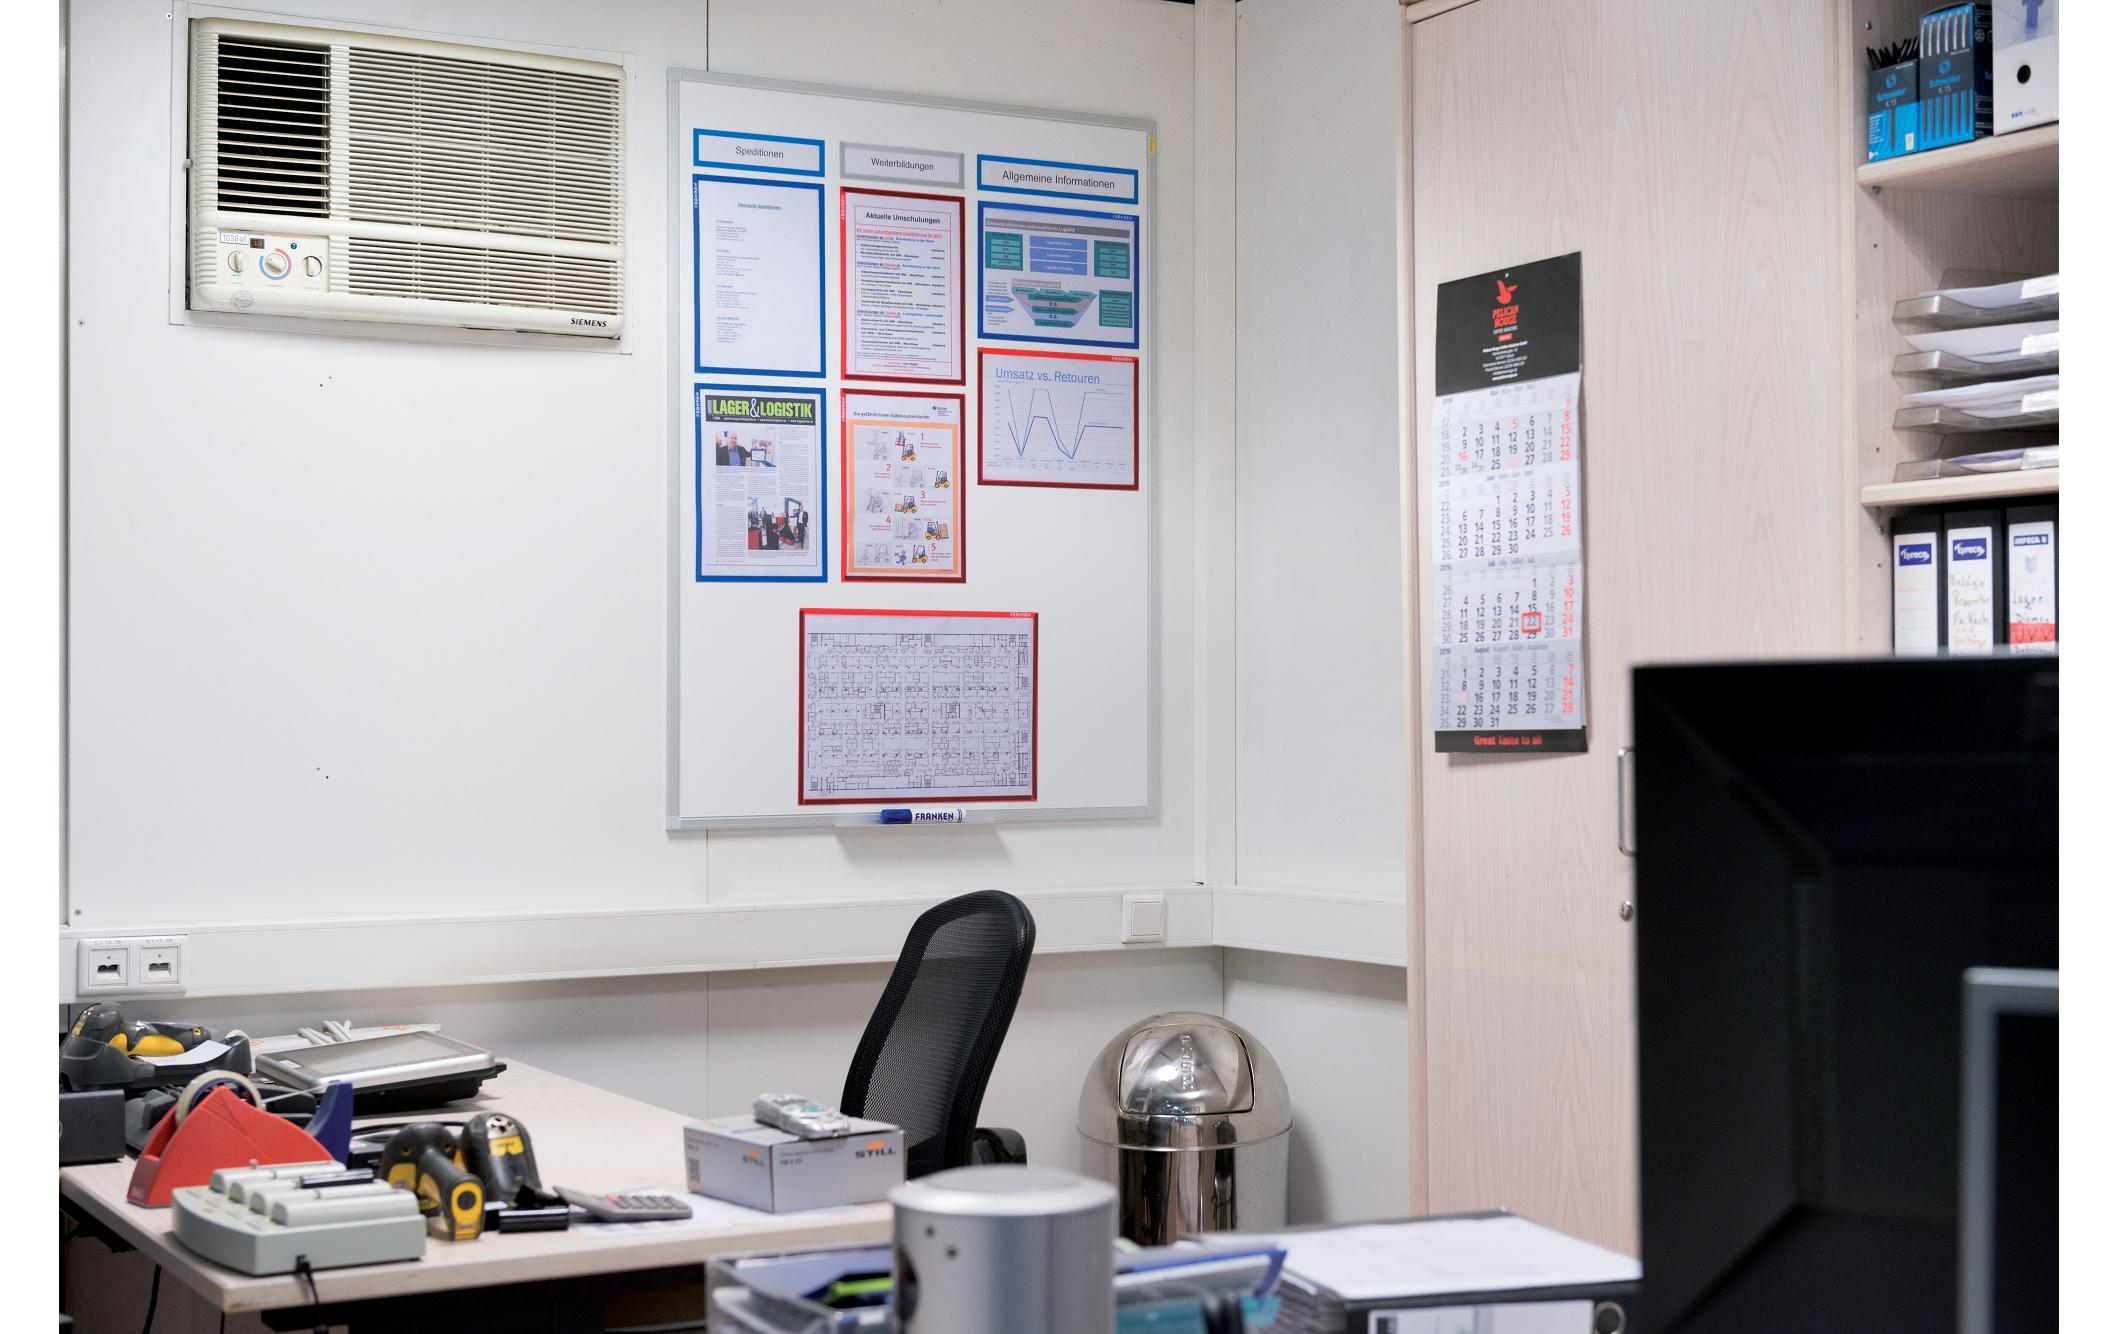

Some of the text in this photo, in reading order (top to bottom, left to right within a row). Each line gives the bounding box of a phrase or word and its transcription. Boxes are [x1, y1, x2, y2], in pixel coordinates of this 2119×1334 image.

[736, 146, 784, 159] Speditionen
[871, 157, 934, 171] Weiterbildungen
[1002, 170, 1115, 189] Allgemeine Informationen
[866, 212, 940, 224] Aktuelle Umschulungen
[570, 317, 607, 328] SIEMENS
[996, 368, 1100, 384] Umsatz vs. Retouren
[1463, 427, 1466, 436] 2
[1480, 424, 1483, 434] 3
[1495, 422, 1499, 431] 4
[1530, 417, 1534, 426] 6
[1463, 440, 1467, 449] 9
[1476, 437, 1484, 446] 10
[1492, 435, 1499, 444] 11
[1509, 432, 1517, 441] 12
[1526, 430, 1534, 439] 13
[1476, 450, 1483, 458] 17
[1492, 447, 1500, 456] 18
[1509, 445, 1518, 454] 19
[1525, 442, 1534, 452] 20
[1492, 460, 1500, 470] 25
[1525, 455, 1534, 465] 27
[1497, 491, 1535, 504] 1 2 3
[1463, 511, 1467, 520] 6
[1480, 509, 1483, 519] 7
[1496, 507, 1500, 517] 8
[1513, 506, 1517, 515] 9
[1526, 504, 1535, 513] 10
[1459, 524, 1467, 533] 13
[1476, 522, 1483, 531] 14
[1492, 520, 1500, 530] 15
[1509, 518, 1518, 528] 16
[1526, 516, 1535, 526] 17
[1459, 536, 1467, 546] 20
[1475, 535, 1483, 544] 21
[1492, 533, 1500, 542] 22
[1509, 531, 1518, 541] 23
[1526, 529, 1535, 539] 24
[1459, 544, 1518, 558] 27 28 29 30
[1533, 578, 1536, 587] 1
[1464, 596, 1468, 605] 4
[1481, 595, 1485, 604] 5
[1497, 593, 1502, 603] 6
[1515, 592, 1519, 601] 7
[1532, 591, 1536, 600] 8
[1460, 608, 1467, 618] 11
[1477, 607, 1484, 617] 12
[1493, 606, 1501, 616] 13
[1510, 605, 1519, 614] 14
[1528, 604, 1537, 613] 15
[1460, 621, 1468, 630] 18
[1476, 620, 1484, 629] 19
[1492, 618, 1502, 628] 20
[1510, 618, 1518, 627] 21
[1527, 617, 1537, 626] 22
[1460, 633, 1468, 642] 25
[1476, 632, 1484, 642] 26
[1493, 631, 1501, 641] 27
[1509, 630, 1519, 640] 28
[1463, 666, 1537, 678] 1 2 3 4 5
[1462, 681, 1466, 690] 8
[1479, 680, 1484, 690] 9
[1492, 680, 1501, 689] 10
[1510, 679, 1518, 688] 11
[1528, 678, 1536, 688] 12
[1475, 693, 1483, 702] 16
[1492, 692, 1500, 701] 17
[1509, 692, 1518, 701] 18
[1528, 691, 1536, 701] 19
[1457, 706, 1466, 715] 22
[1474, 705, 1483, 715] 23
[1490, 705, 1500, 714] 24
[1508, 704, 1518, 714] 25
[1526, 704, 1536, 714] 26
[1457, 717, 1499, 727] 29 30 31
[1474, 736, 1496, 745] Great
[1532, 735, 1542, 744] all
[915, 812, 954, 821] FRANKEN
[855, 1148, 896, 1159] STILL
[742, 1155, 765, 1168] STILL
